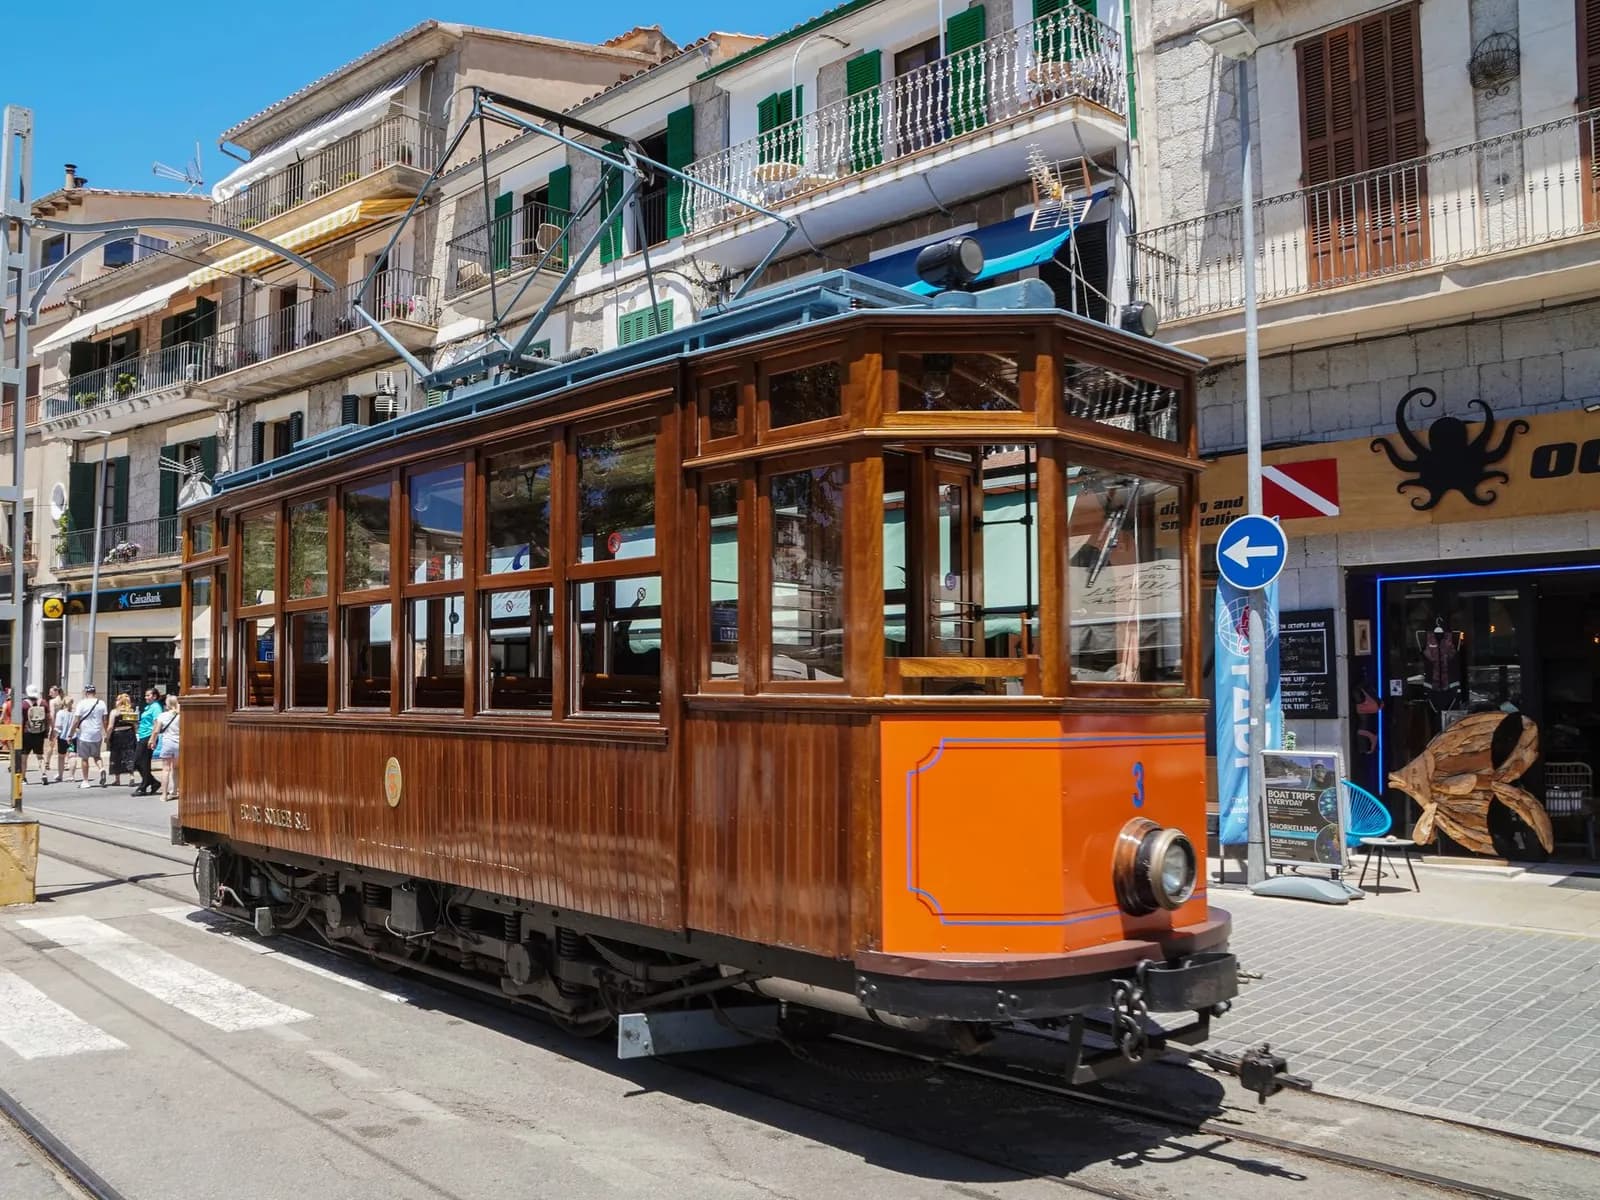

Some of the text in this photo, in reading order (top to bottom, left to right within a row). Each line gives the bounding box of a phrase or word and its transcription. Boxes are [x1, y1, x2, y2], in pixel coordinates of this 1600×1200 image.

[1213, 496, 1244, 510] and
[129, 592, 161, 605] CaixaBank
[1133, 762, 1145, 808] 3
[1268, 790, 1316, 801] BOAT TRIPS
[1268, 799, 1304, 807] EVERYDAY
[264, 808, 292, 828] SOLLER
[1270, 823, 1318, 833] SNORKELLING
